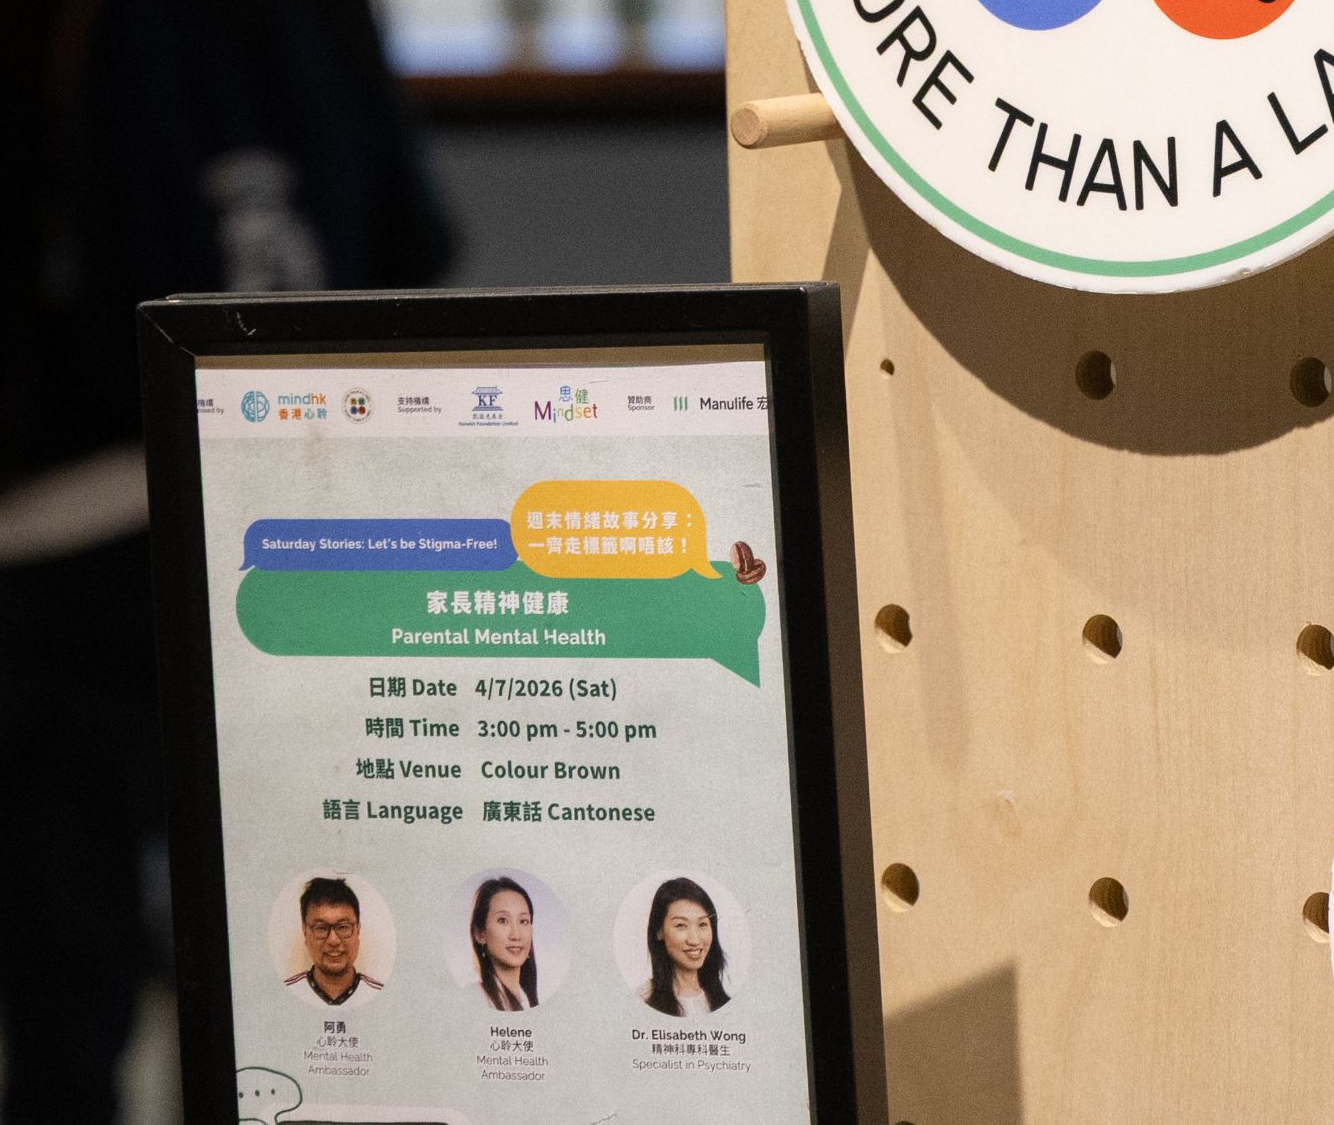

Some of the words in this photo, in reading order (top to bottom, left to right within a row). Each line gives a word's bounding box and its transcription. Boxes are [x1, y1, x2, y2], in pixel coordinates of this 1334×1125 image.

[988, 98, 1179, 211] THAN
[1212, 119, 1262, 197] A
[278, 393, 327, 405] mindhk
[478, 395, 497, 406] KF
[559, 385, 589, 404] 思健
[700, 396, 754, 410] Manulife
[397, 406, 432, 414] Supported
[434, 406, 442, 415] by
[534, 401, 599, 423] Mindset
[262, 538, 316, 552] Saturday
[319, 538, 364, 550] Stories:
[400, 538, 415, 550] be
[418, 538, 498, 552] Stigma-Free!
[426, 590, 569, 615] 家長精神健康
[392, 628, 469, 644] Parental
[475, 628, 539, 645] Mental
[544, 629, 606, 645] Health
[369, 676, 406, 698] 日期
[412, 678, 458, 697] Date
[475, 678, 563, 700] 4/7/2026
[569, 678, 617, 701] (Sat)
[365, 717, 404, 739] 時間
[409, 719, 460, 737] Time
[478, 720, 520, 738] 3:00
[526, 724, 558, 742] pm
[576, 721, 618, 738] 5:00
[624, 724, 657, 742] pm
[356, 758, 395, 780] 地點
[399, 760, 461, 779] Venue
[481, 760, 548, 779] Colour
[554, 761, 620, 779] Brown
[322, 799, 361, 821] 語言
[367, 801, 463, 824] Language
[482, 800, 542, 822] 廣東話
[547, 803, 655, 821] Cantonese
[490, 1026, 532, 1037] Helene
[632, 1029, 648, 1040] Dr.
[651, 1029, 707, 1041] Elisabeth
[710, 1030, 746, 1044] Wong
[304, 1051, 338, 1061] Mental
[341, 1052, 373, 1062] Health
[476, 1055, 512, 1066] Mental
[515, 1056, 548, 1066] Health
[308, 1065, 369, 1076] Ambassador
[632, 1059, 683, 1071] Specialist
[686, 1060, 695, 1070] in
[697, 1059, 752, 1073] Psychiatry
[481, 1069, 545, 1081] Ambassador
